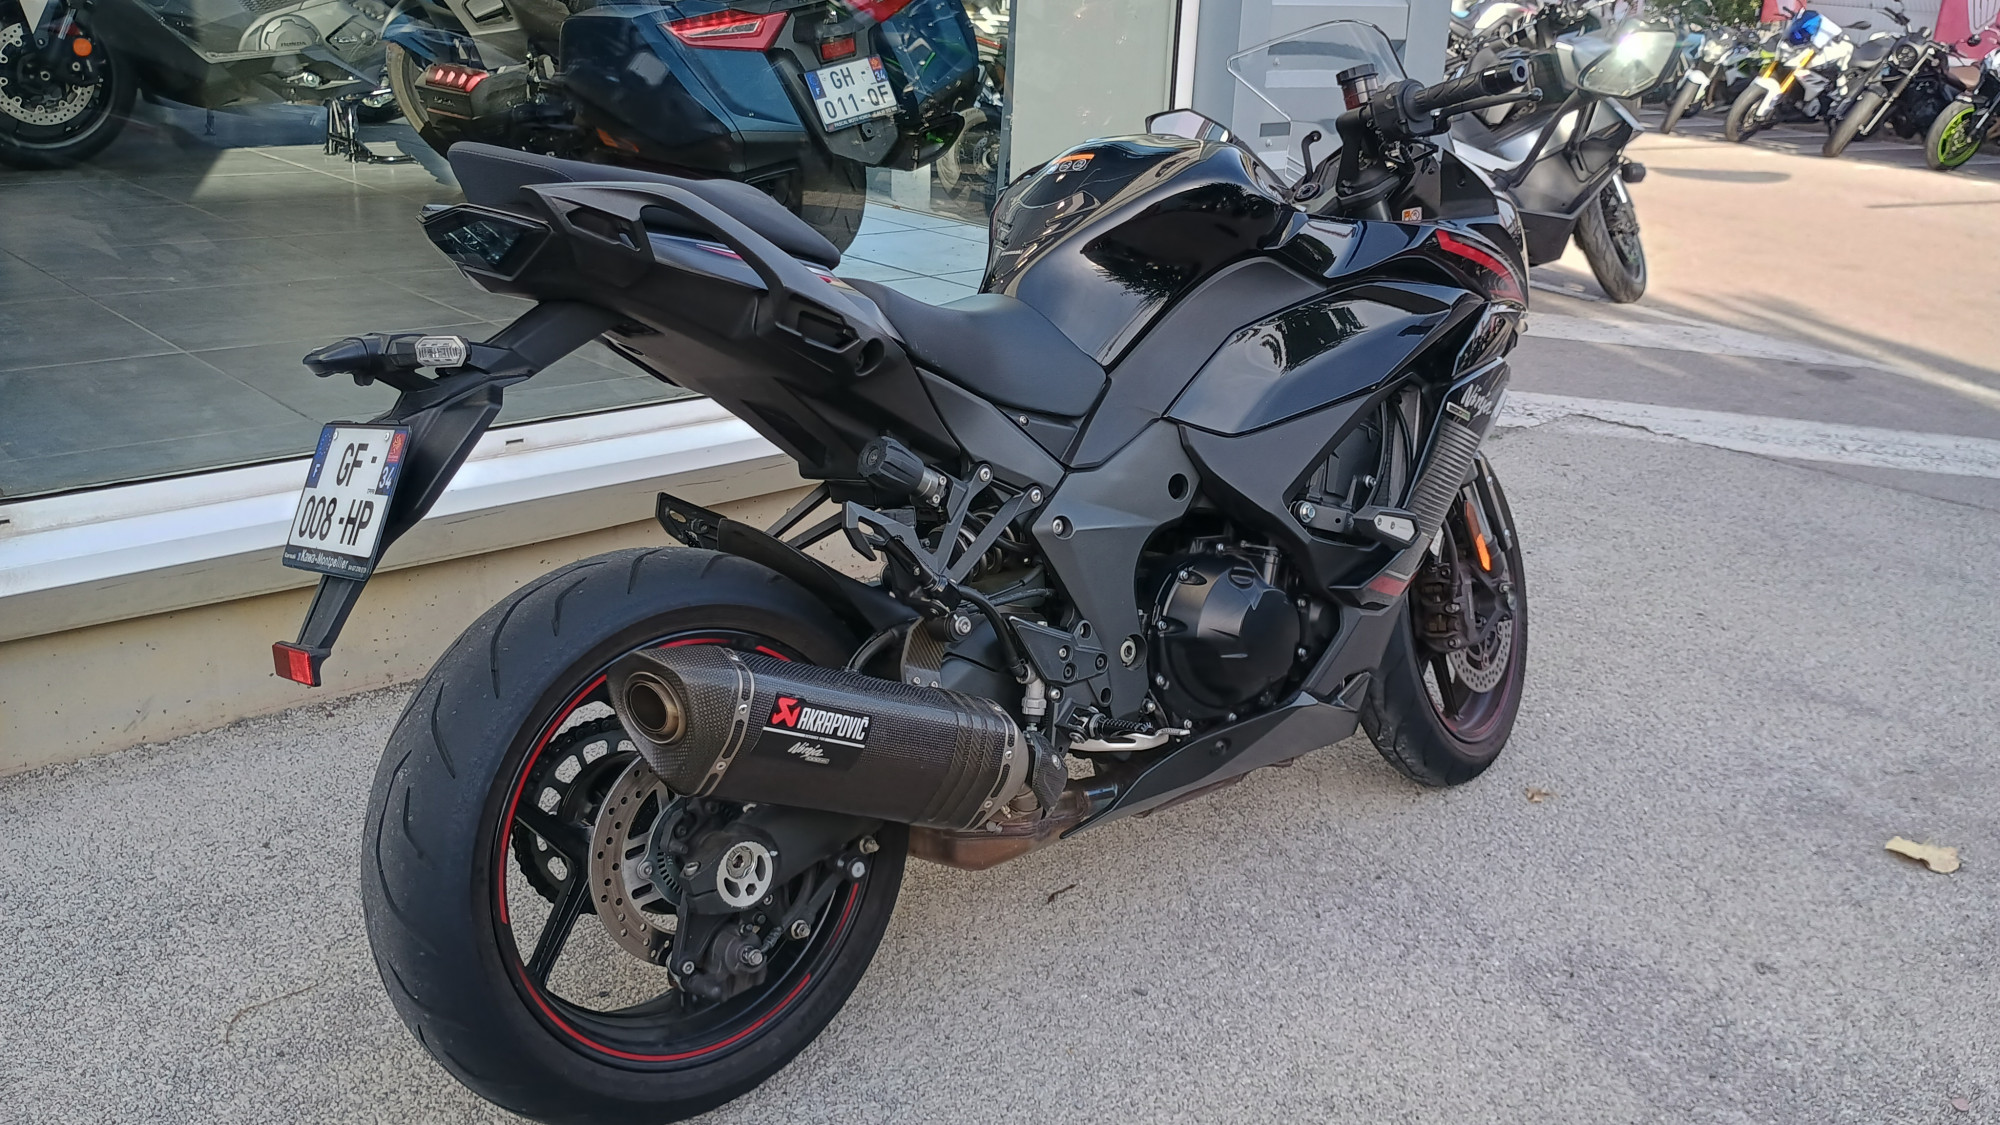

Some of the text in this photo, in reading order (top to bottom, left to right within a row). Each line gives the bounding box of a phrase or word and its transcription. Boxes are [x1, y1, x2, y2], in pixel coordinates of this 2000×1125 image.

[874, 70, 886, 81] 34
[815, 87, 821, 95] F
[1460, 383, 1492, 418] Ninja
[312, 463, 321, 477] F
[379, 466, 395, 490] 34
[787, 741, 824, 758] Ninja
